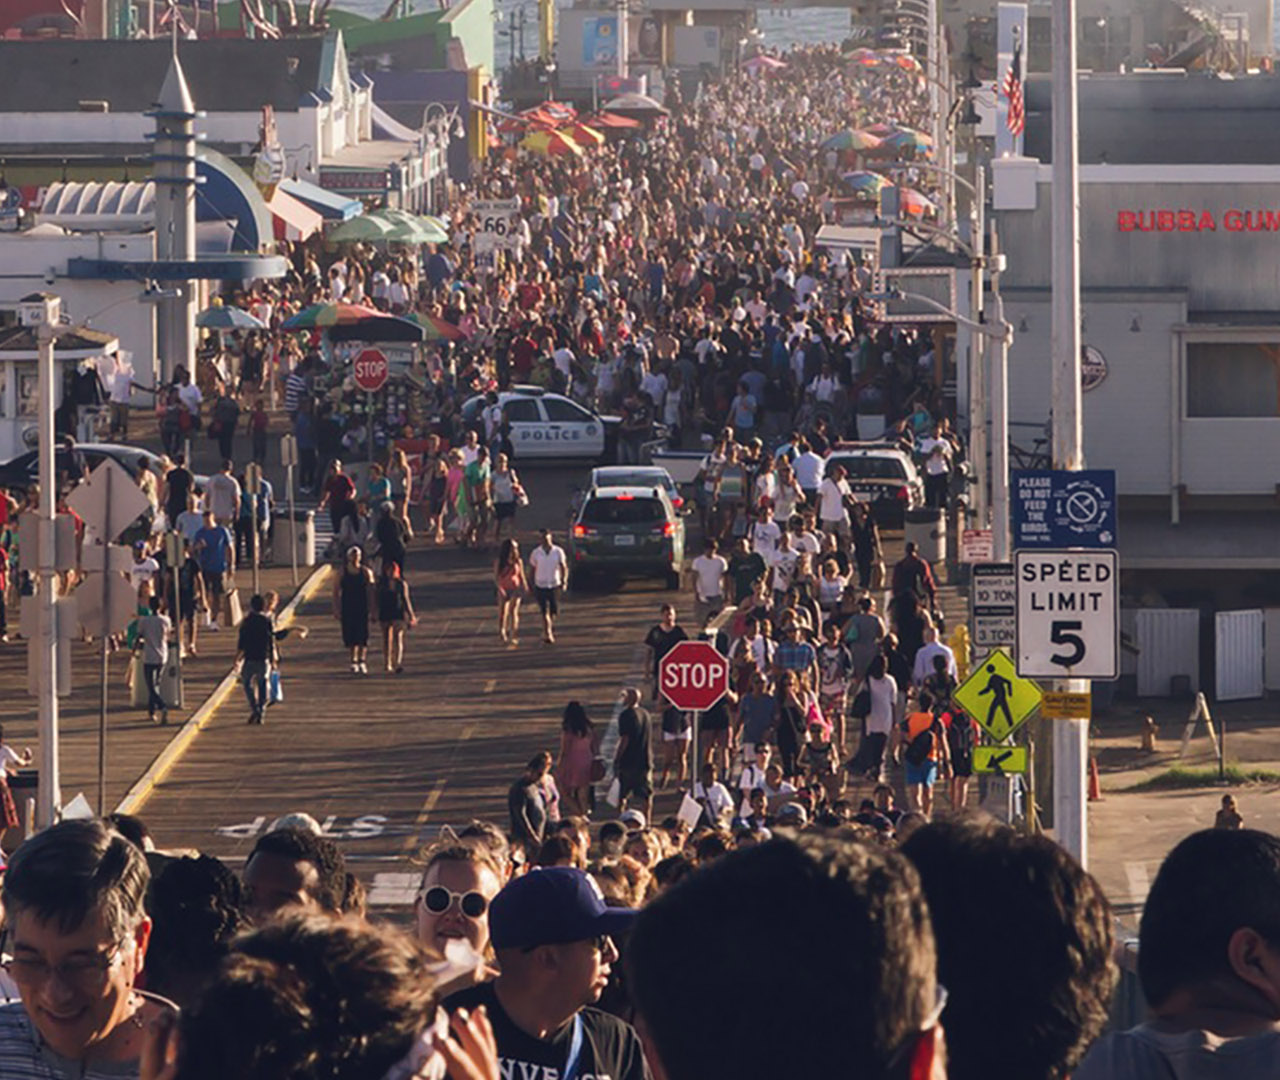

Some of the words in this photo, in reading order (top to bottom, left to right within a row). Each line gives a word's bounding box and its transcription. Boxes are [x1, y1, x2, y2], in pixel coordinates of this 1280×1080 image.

[484, 216, 506, 236] 66
[1117, 209, 1217, 233] BUBBA
[356, 361, 387, 378] STOP
[521, 430, 580, 440] POLICE
[1019, 478, 1052, 487] PLEASE
[1019, 489, 1032, 498] DO
[1034, 489, 1051, 498] NOT
[1024, 500, 1047, 510] FEED
[1027, 512, 1044, 521] THE
[1022, 563, 1110, 582] SPEED
[977, 590, 989, 601] 10
[994, 591, 1015, 601] TON
[1031, 592, 1102, 611] LIMIT
[979, 629, 986, 640] 3
[991, 629, 1014, 640] TON
[1050, 620, 1086, 667] 5
[664, 663, 724, 689] STOP
